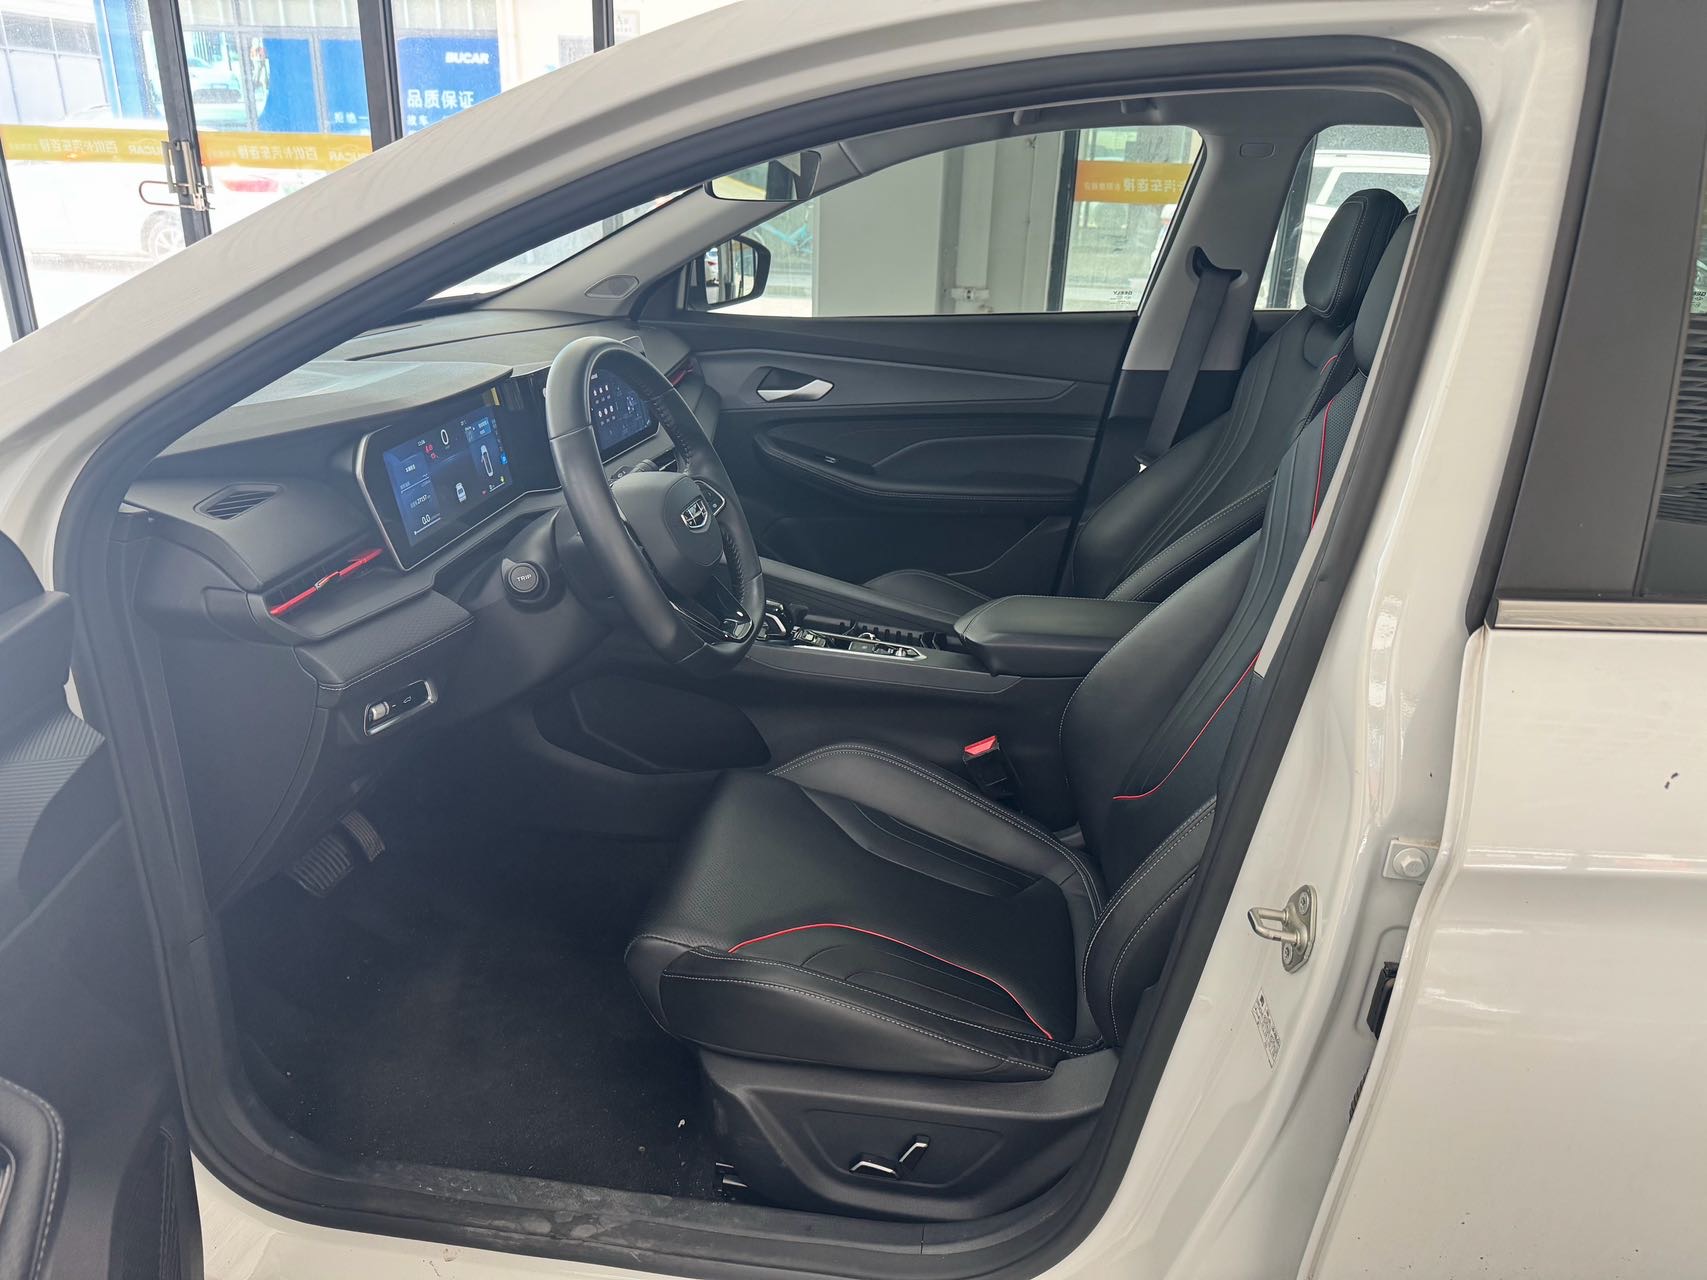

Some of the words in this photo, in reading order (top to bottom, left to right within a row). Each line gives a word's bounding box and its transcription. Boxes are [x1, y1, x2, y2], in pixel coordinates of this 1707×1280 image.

[445, 51, 489, 64] BUCAR
[407, 89, 474, 109] 品质保证
[441, 428, 449, 445] 0
[421, 514, 431, 525] 0.0
[516, 573, 532, 582] TRIP
